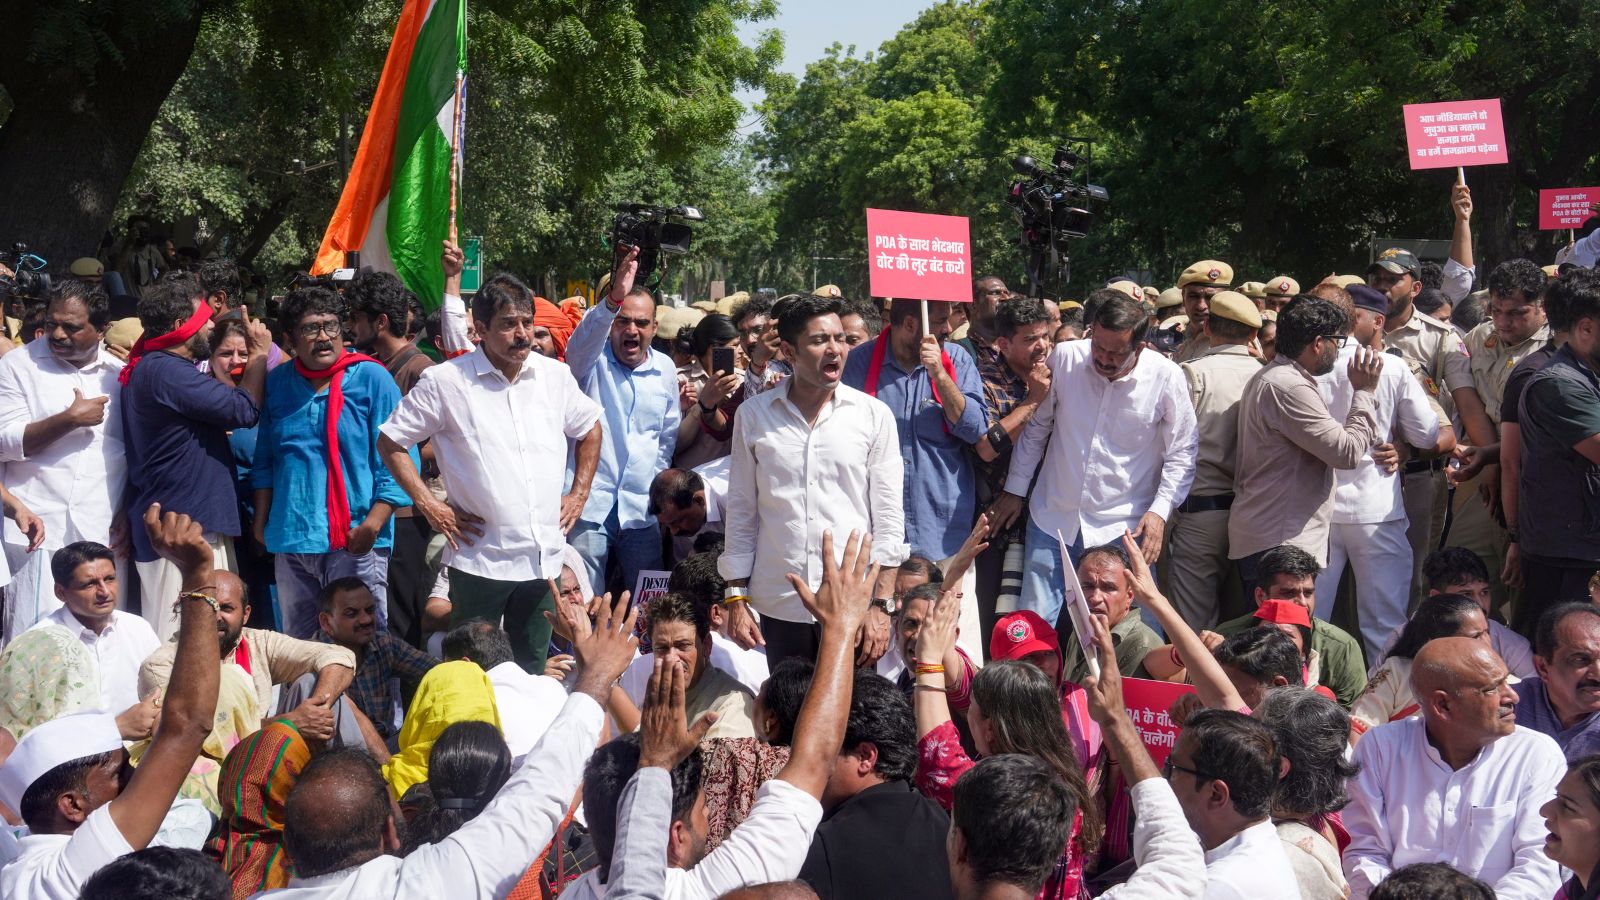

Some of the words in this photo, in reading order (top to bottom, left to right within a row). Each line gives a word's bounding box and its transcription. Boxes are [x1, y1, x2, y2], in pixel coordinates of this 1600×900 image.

[1420, 115, 1435, 123] आप
[1460, 122, 1486, 132] मतलब
[1437, 136, 1459, 144] समझ
[1417, 148, 1426, 156] या
[1428, 146, 1440, 156] हमें
[1442, 146, 1476, 155] समझाना
[876, 235, 896, 249] PDA
[897, 234, 907, 249] के
[908, 238, 930, 252] साथ
[932, 237, 964, 254] भेदभाव
[876, 252, 894, 269] वोट
[895, 253, 909, 270] की
[910, 258, 928, 276] लूट
[929, 256, 943, 272] बंद
[944, 258, 965, 274] करो
[1126, 708, 1140, 723] DA
[1143, 707, 1155, 724] के
[1143, 729, 1176, 747] चलेगी
